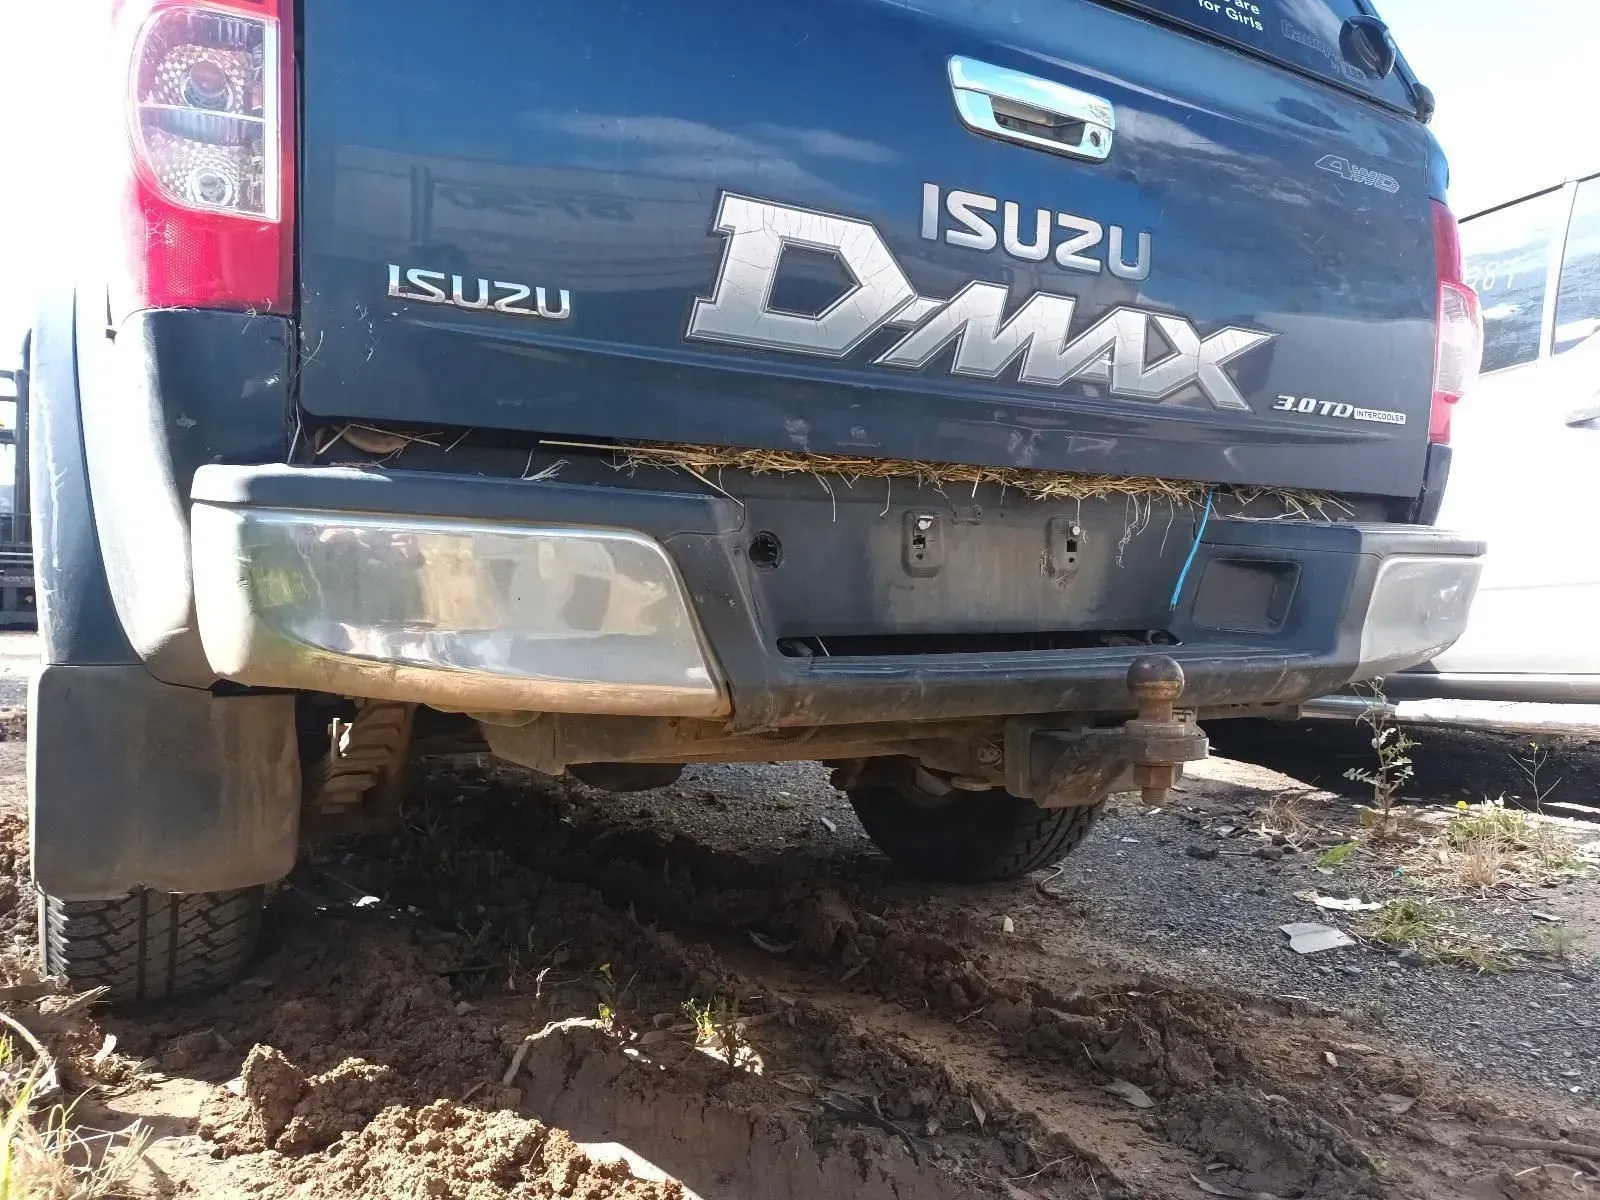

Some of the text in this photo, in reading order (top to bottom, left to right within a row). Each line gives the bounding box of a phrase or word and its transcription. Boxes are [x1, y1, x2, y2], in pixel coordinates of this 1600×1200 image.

[1225, 7, 1263, 31] Girls
[1315, 154, 1400, 193] 4WD
[921, 182, 1153, 281] ISUZU
[388, 264, 570, 319] ISUZU
[682, 189, 1281, 412] D-MAX
[1355, 409, 1405, 423] INTERCOOLER
